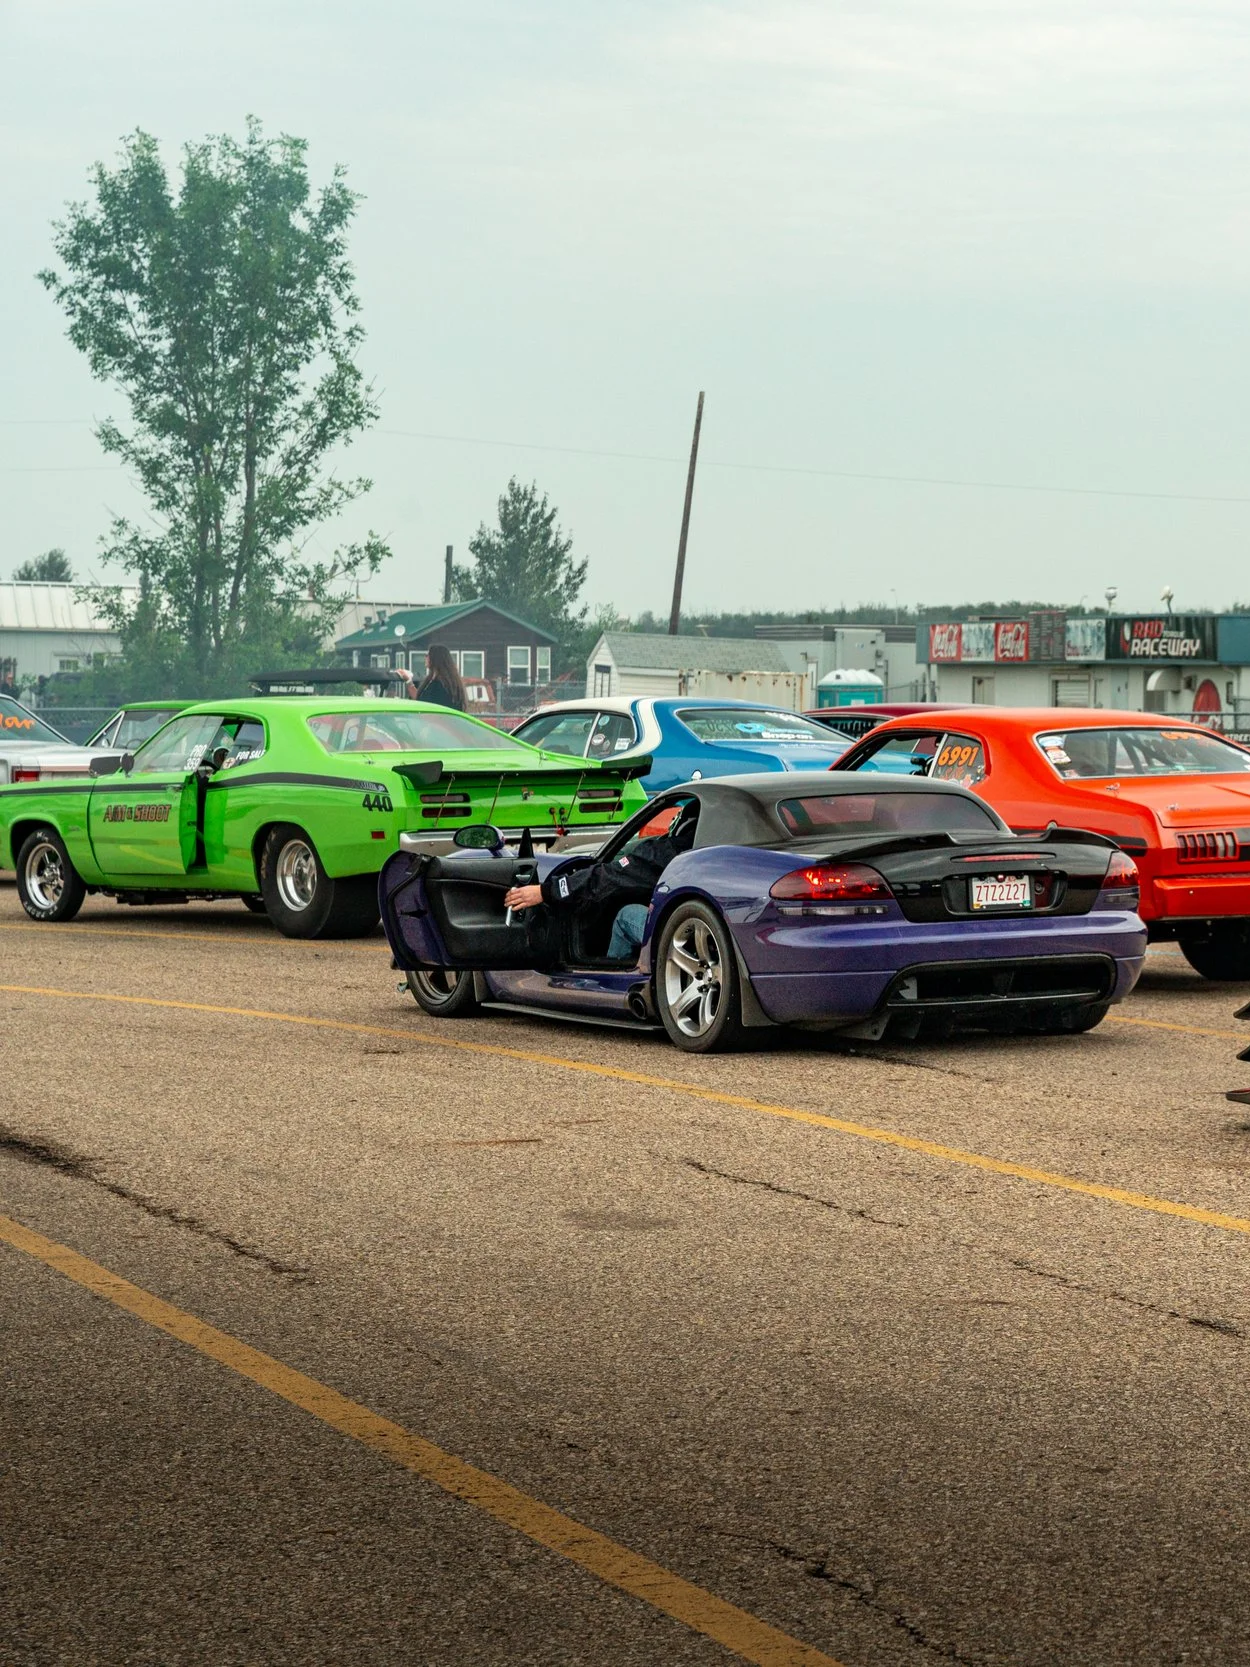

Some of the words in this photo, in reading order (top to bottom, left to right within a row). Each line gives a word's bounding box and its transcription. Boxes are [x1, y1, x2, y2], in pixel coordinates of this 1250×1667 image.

[1133, 621, 1164, 638] RAD
[1131, 639, 1200, 656] RACEWAY
[235, 751, 249, 760] FOR
[938, 745, 979, 766] 6991
[362, 794, 393, 812] 440
[133, 804, 172, 822] SHOOT
